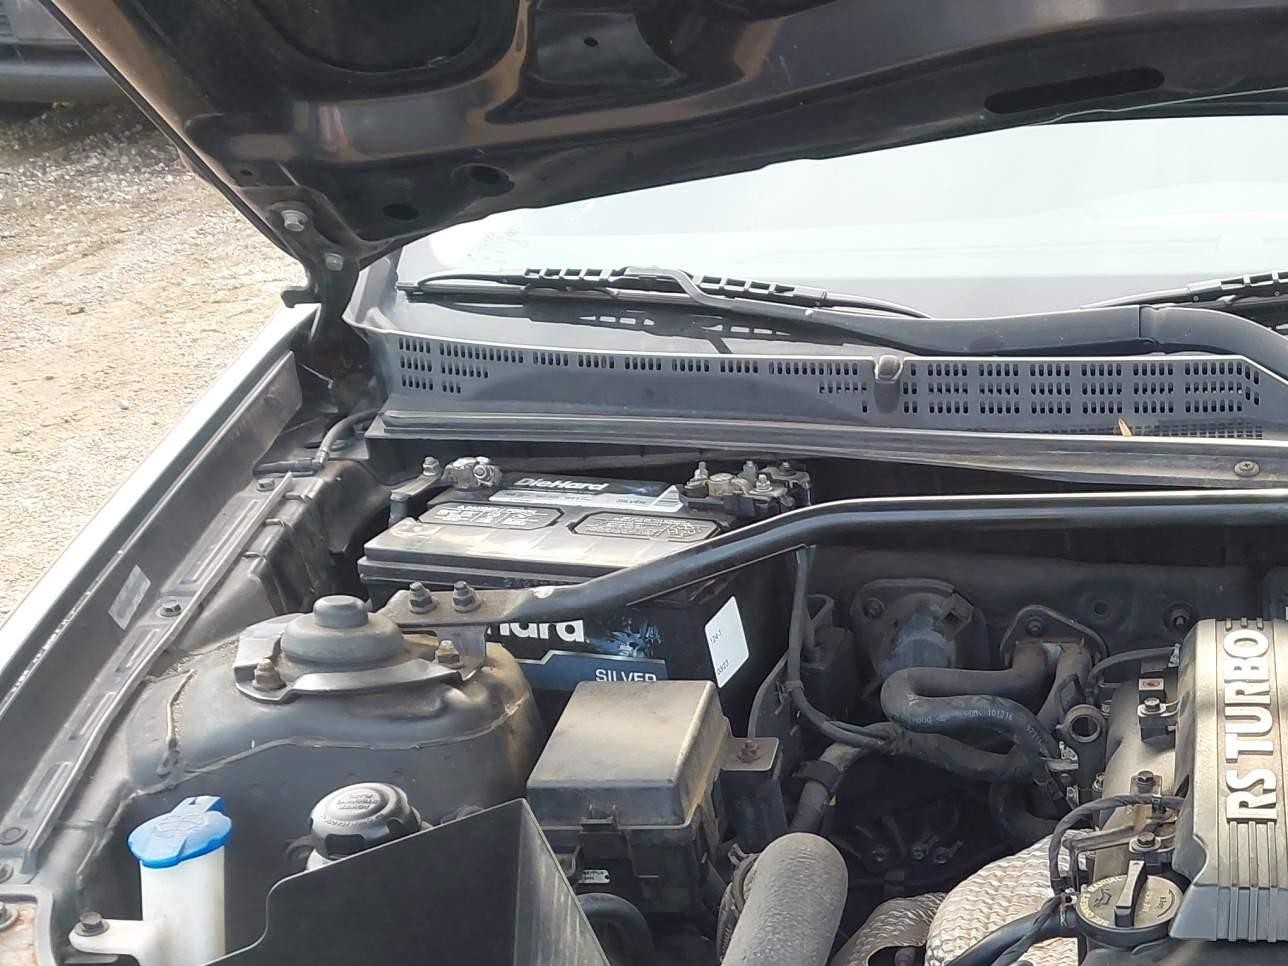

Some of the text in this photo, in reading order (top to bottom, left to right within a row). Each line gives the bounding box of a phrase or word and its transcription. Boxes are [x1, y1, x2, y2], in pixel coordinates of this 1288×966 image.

[514, 477, 609, 491] DieHard
[1223, 629, 1278, 823] RS TURBO
